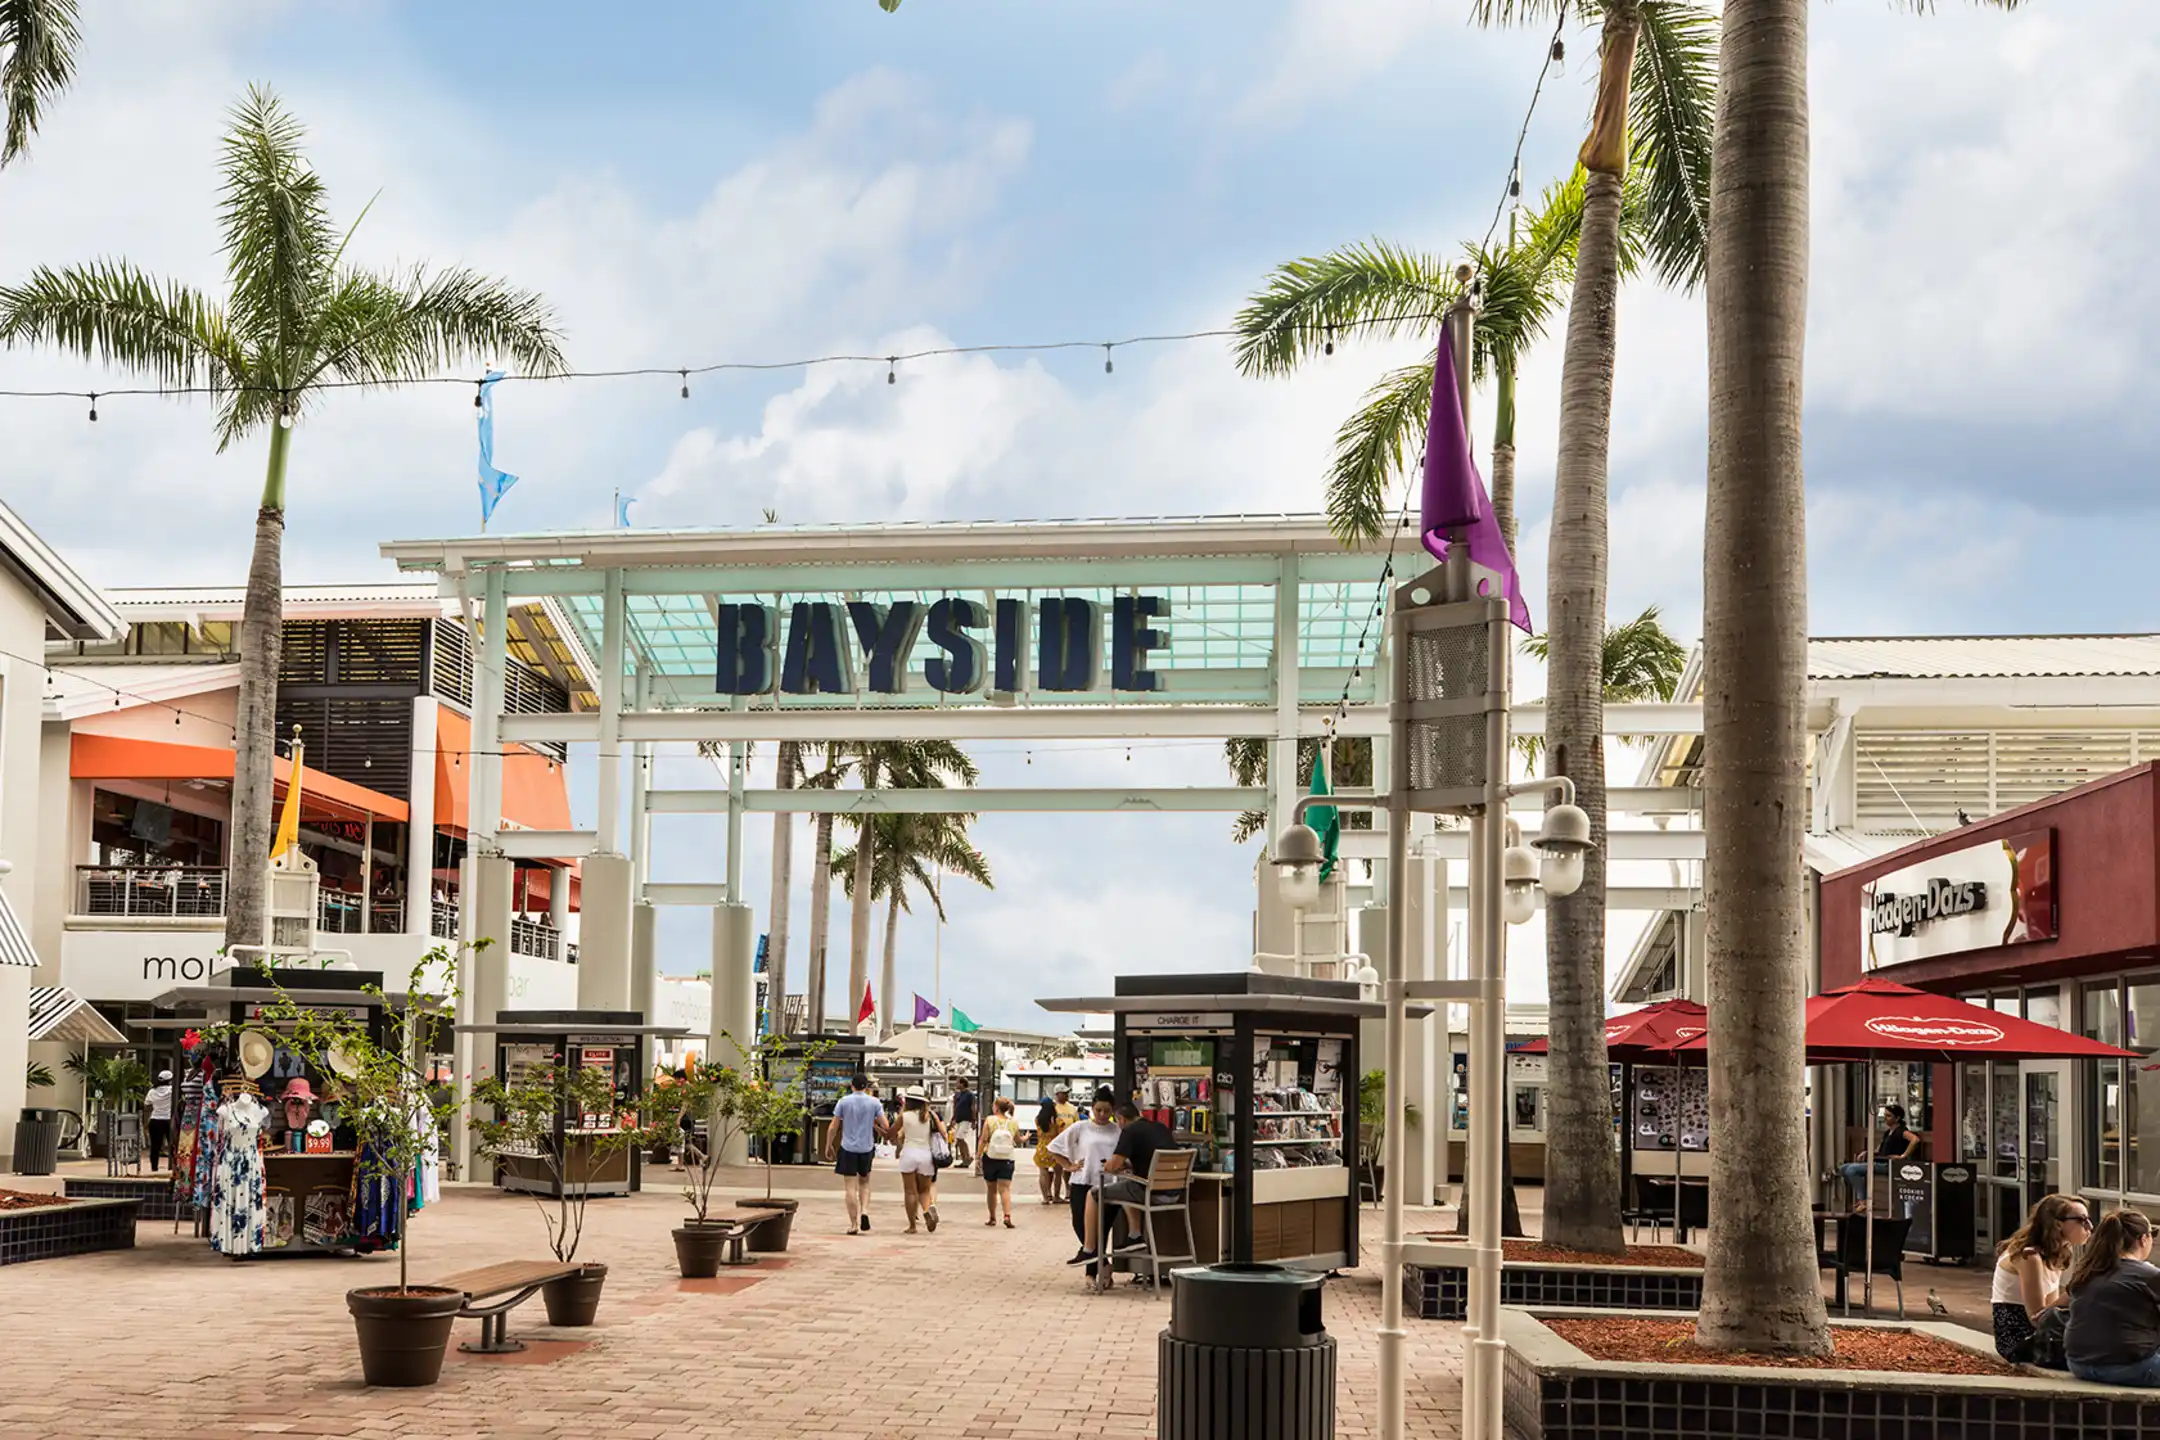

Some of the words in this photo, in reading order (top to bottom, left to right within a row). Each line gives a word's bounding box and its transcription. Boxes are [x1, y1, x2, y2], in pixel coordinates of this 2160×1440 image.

[715, 597, 1170, 694] BAYSIDE
[1869, 878, 1984, 937] Häagen-Dazs
[1157, 1016, 1190, 1025] CHARGE
[1192, 1016, 1200, 1025] IT
